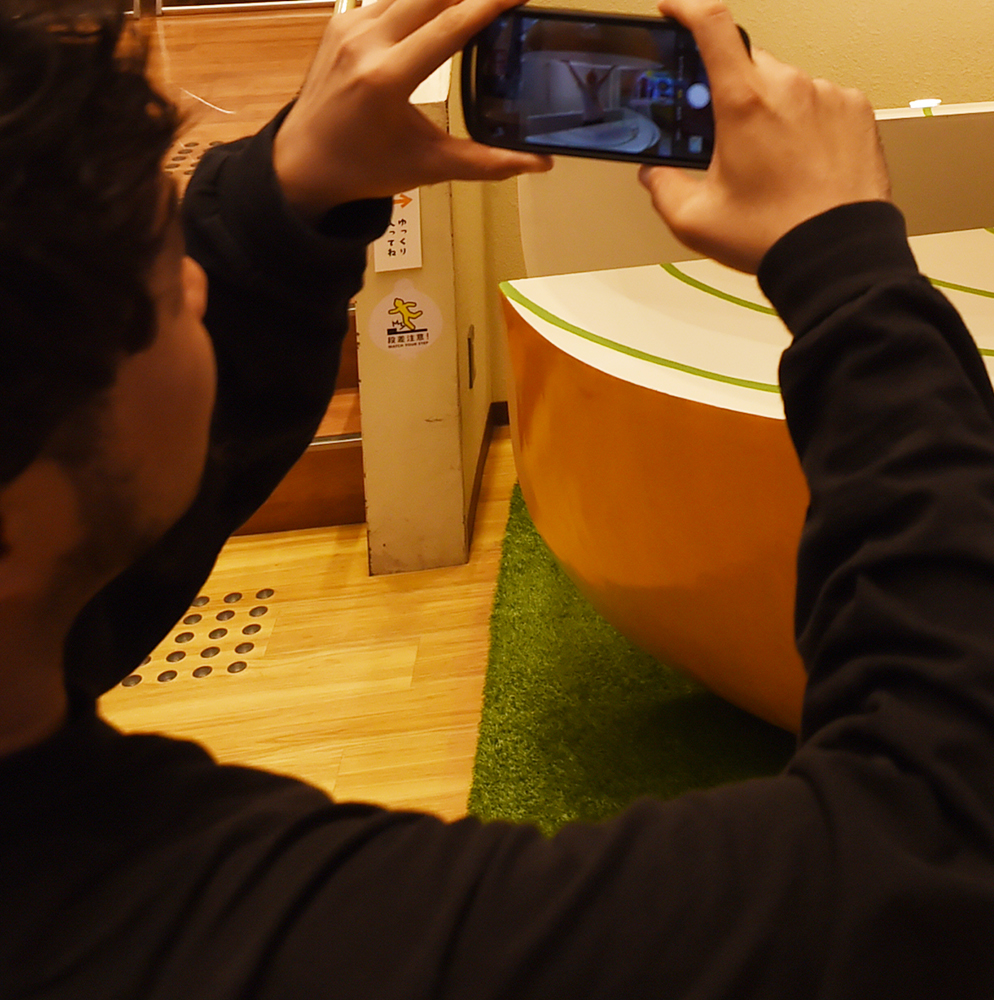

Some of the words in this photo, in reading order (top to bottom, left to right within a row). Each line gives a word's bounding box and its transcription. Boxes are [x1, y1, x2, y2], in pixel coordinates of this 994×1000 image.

[397, 218, 408, 256] ゆっくり
[387, 332, 430, 345] 段差注意！
